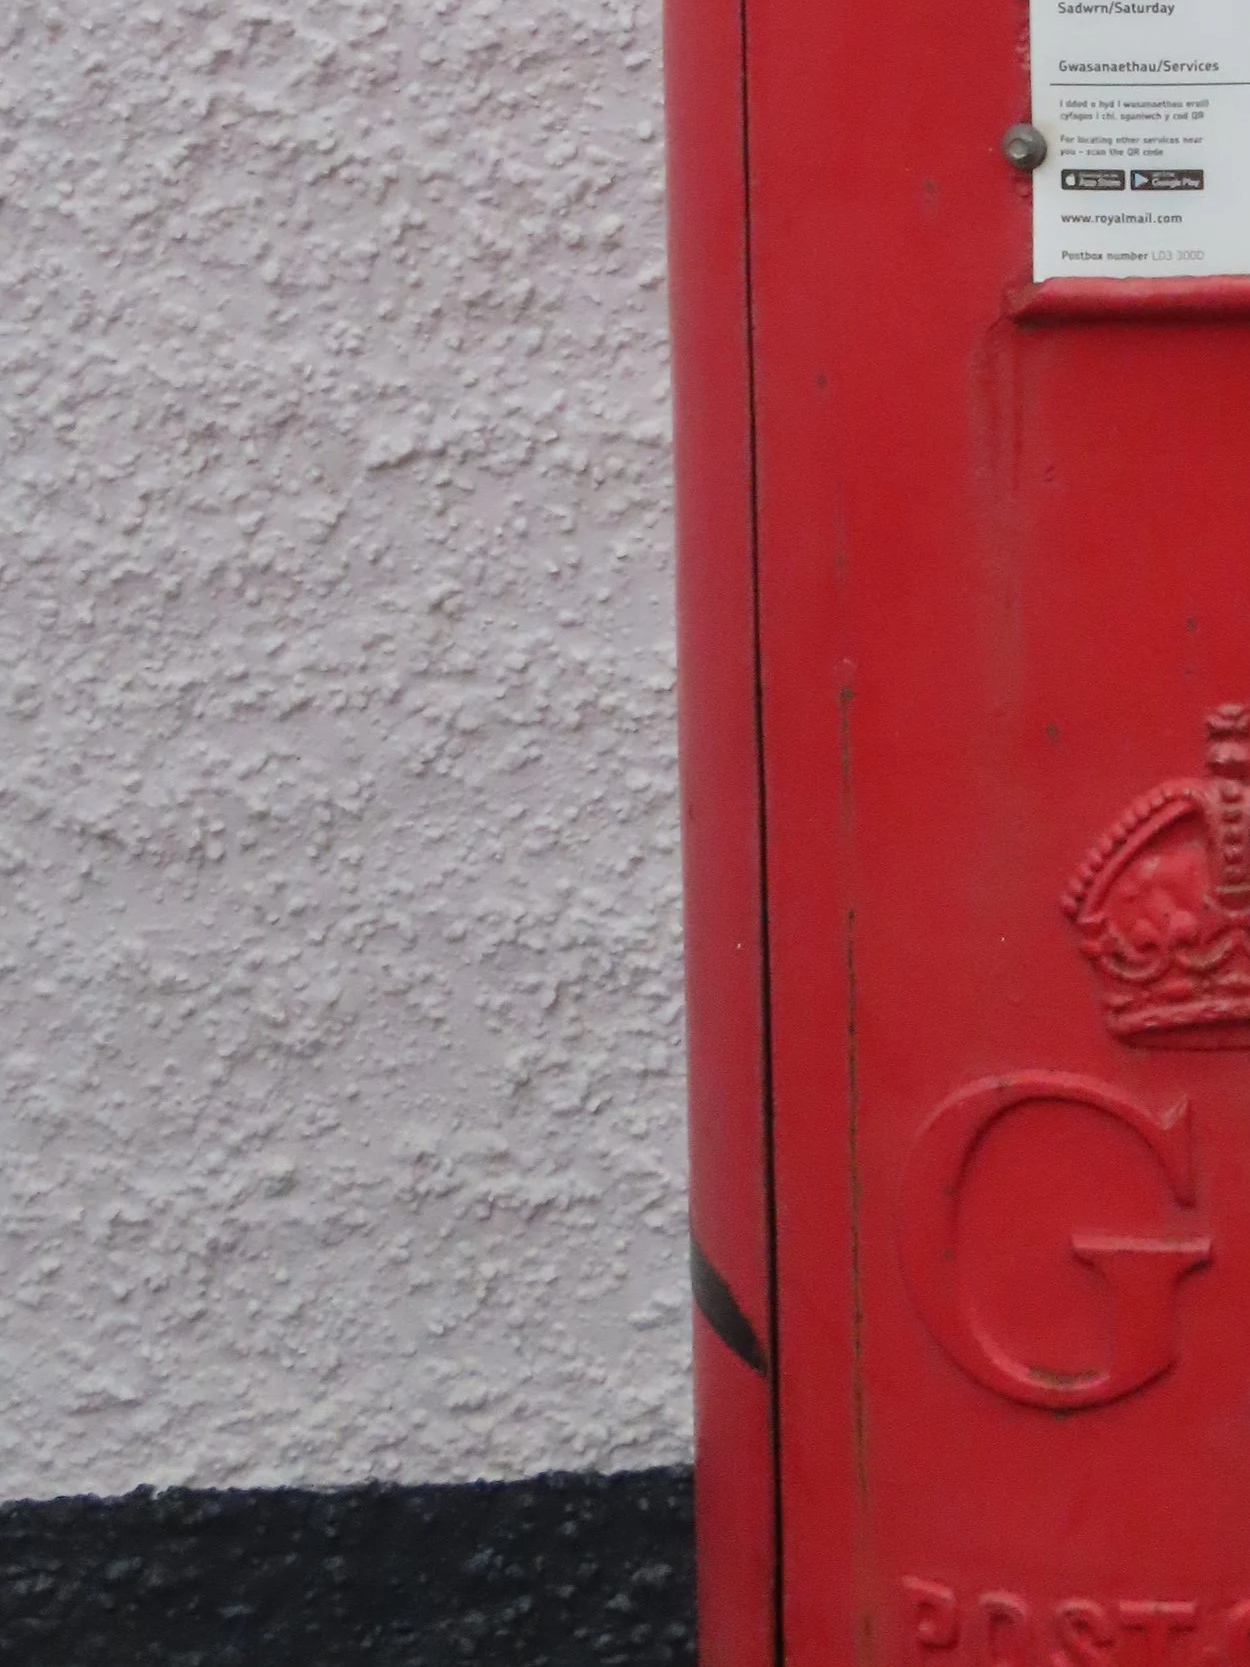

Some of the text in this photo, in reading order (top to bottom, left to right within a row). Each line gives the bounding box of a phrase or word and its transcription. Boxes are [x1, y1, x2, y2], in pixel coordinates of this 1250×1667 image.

[1058, 1, 1175, 15] Sadwrn/Saturday
[1058, 59, 1220, 73] Gwasanaethau/Services
[1099, 99, 1115, 110] hyd
[1191, 111, 1205, 119] QR
[1060, 135, 1075, 143] For
[1077, 135, 1113, 145] locating
[1115, 135, 1139, 144] other
[1143, 135, 1180, 144] services
[1060, 149, 1076, 157] you
[1109, 148, 1124, 156] the
[1126, 148, 1140, 157] QR
[1143, 148, 1163, 156] code
[1061, 213, 1182, 226] www.royalmail.com
[1061, 251, 1103, 261] Postbox
[1107, 250, 1148, 261] number
[902, 1575, 1198, 1666] POST
